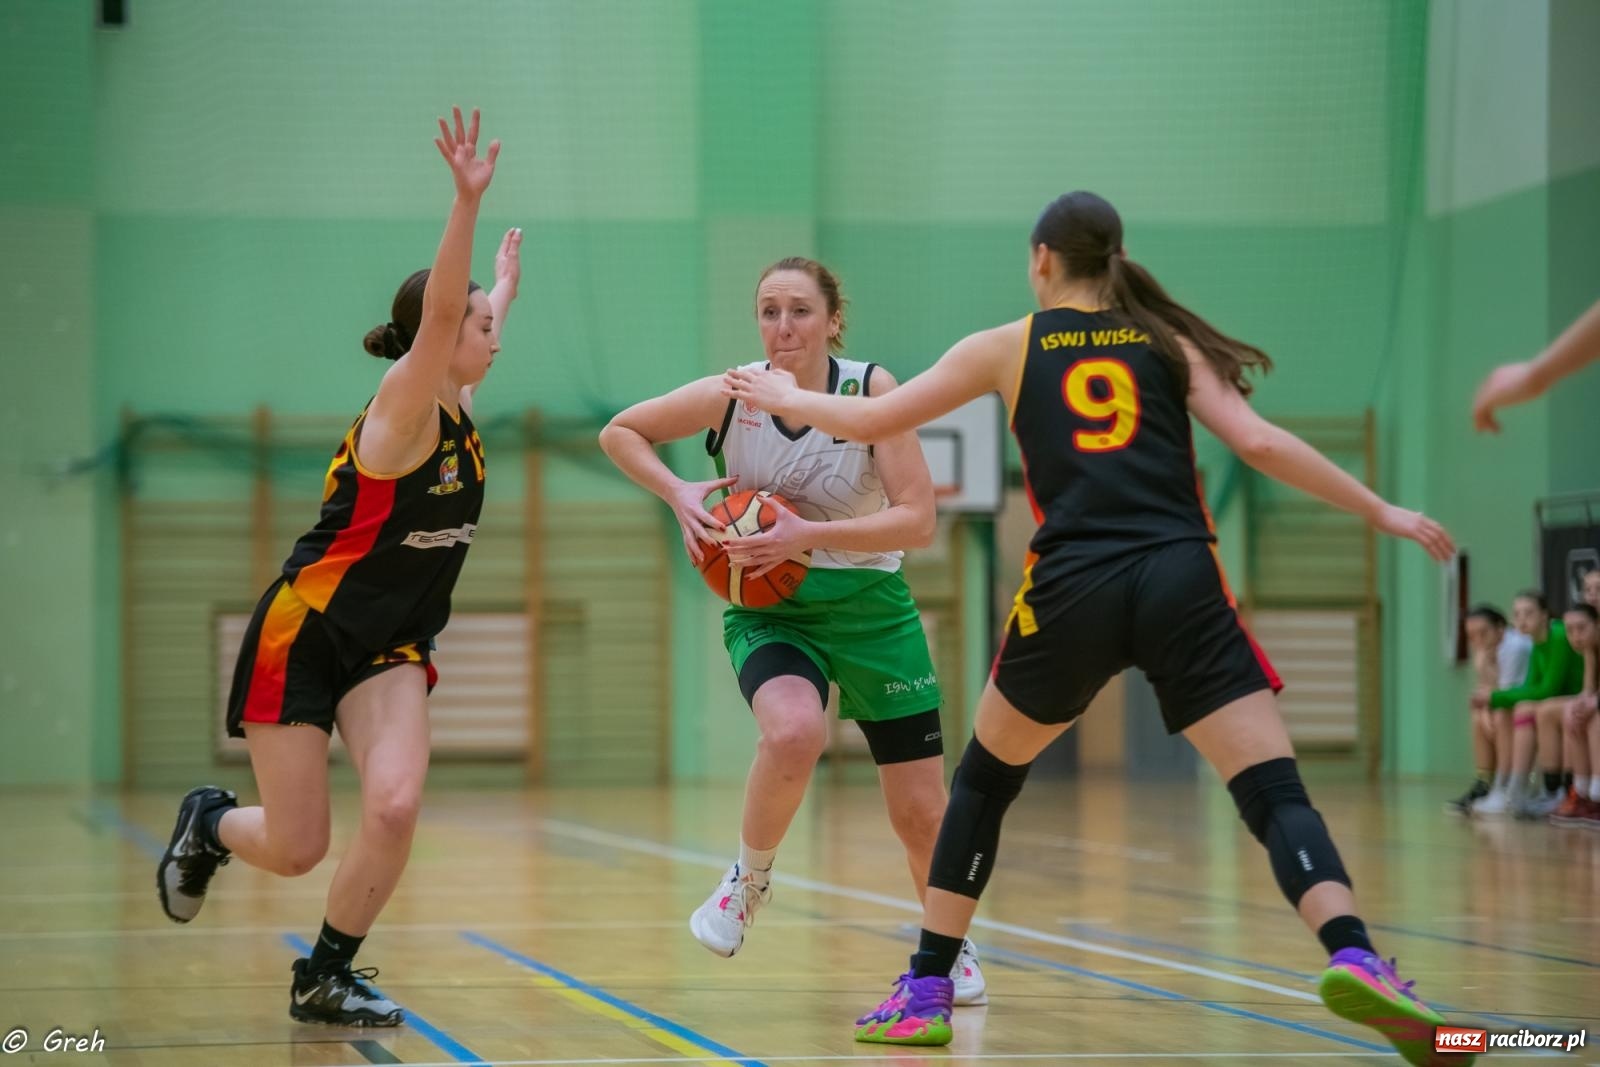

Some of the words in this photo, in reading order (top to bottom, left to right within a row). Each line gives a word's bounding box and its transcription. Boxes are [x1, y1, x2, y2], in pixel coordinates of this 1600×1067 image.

[1040, 331, 1086, 350] ISWJ
[1061, 356, 1141, 453] 9
[967, 852, 983, 881] TARMAK
